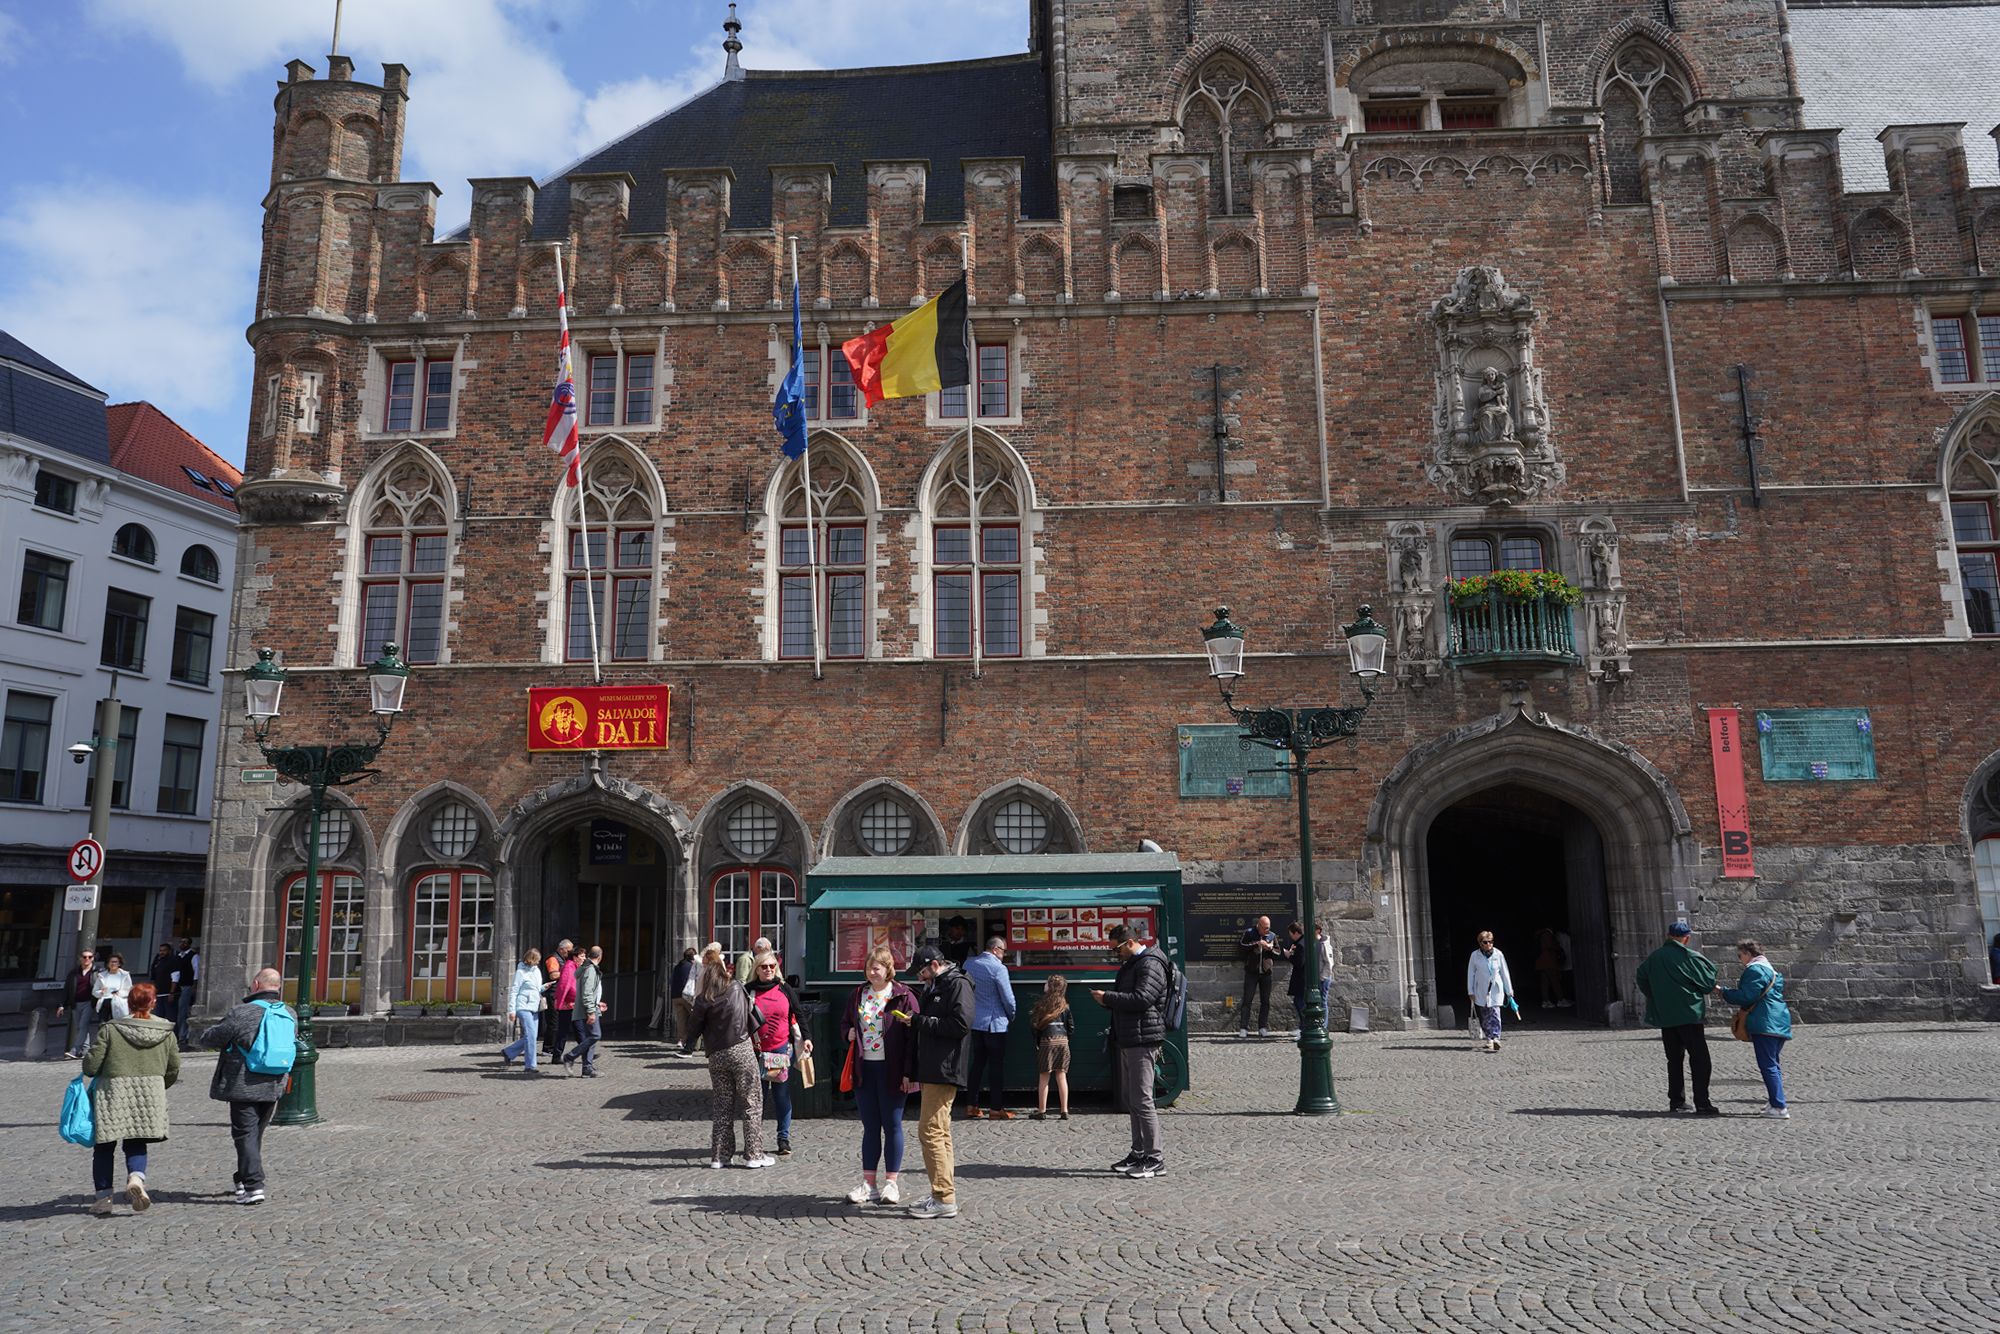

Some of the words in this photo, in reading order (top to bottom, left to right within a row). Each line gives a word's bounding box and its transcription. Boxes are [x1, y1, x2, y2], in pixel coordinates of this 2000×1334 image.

[597, 707, 657, 720] SALVADOR
[597, 720, 657, 744] DALI
[1720, 716, 1731, 753] Belfort
[1723, 831, 1750, 856] B
[1726, 862, 1752, 870] Brugge
